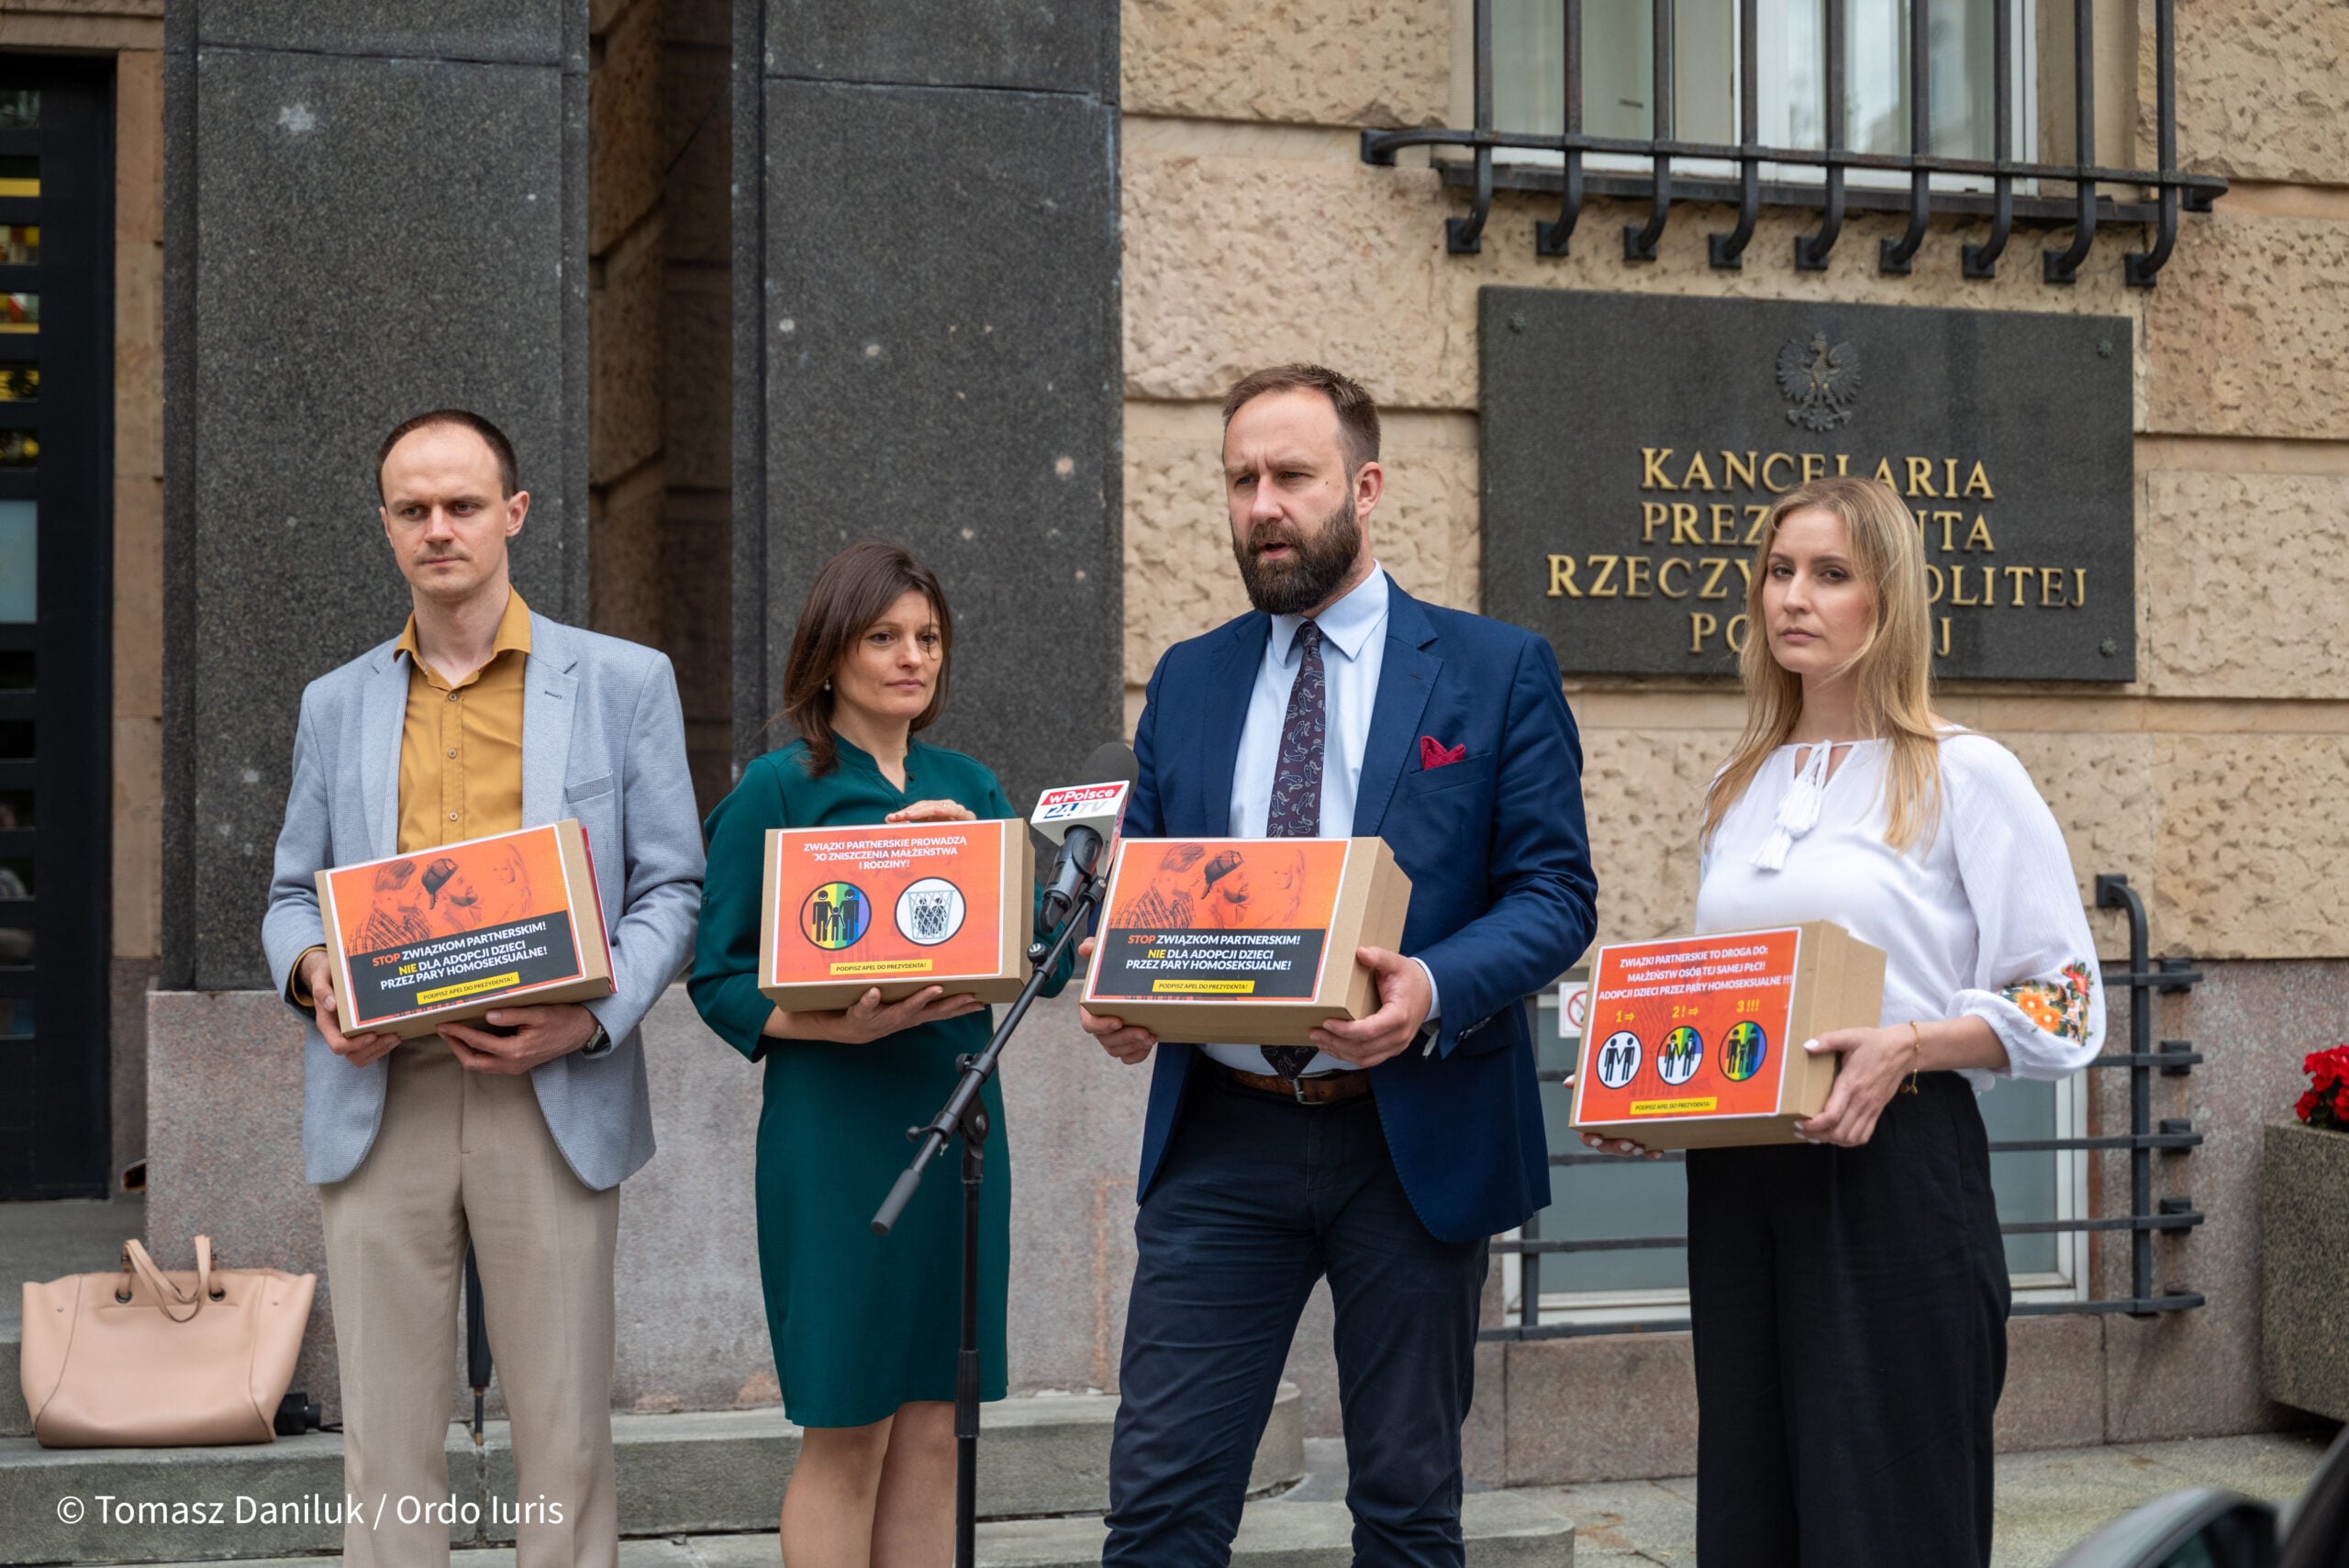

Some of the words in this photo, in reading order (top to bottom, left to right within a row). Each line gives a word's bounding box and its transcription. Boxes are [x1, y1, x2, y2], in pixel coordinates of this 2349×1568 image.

[1050, 789, 1115, 803] wPolsce
[804, 841, 845, 853] ZWIĄZKI
[846, 838, 909, 850] PARTNERSKIE
[911, 836, 967, 847] PROWADZĄ
[829, 850, 889, 861] ZNISZCZENIA
[891, 845, 957, 858] MAŁŻEŃSTWA
[863, 860, 909, 869] RODZINY!
[372, 952, 400, 967] STOP
[402, 940, 466, 962] ZWIĄZKOM
[467, 921, 547, 946] PARTNERSKIM!
[1128, 935, 1155, 944] STOP
[1157, 935, 1220, 946] ZWIĄZKOM
[1220, 935, 1300, 945] PARTNERSKIM!
[398, 963, 417, 975] NIE
[418, 959, 441, 972] DLA
[442, 948, 490, 968] ADOPCJI
[491, 940, 526, 956] DZIECI
[1148, 949, 1166, 959] NIE
[1167, 950, 1188, 959] DLA
[1190, 950, 1237, 959] ADOPCJI
[1239, 950, 1274, 959] DZIECI
[1620, 957, 1654, 968] ZWIĄZKI
[1655, 951, 1708, 964] PARTNERSKIE
[1709, 950, 1720, 959] TO
[1721, 948, 1752, 958] DROGA
[1753, 946, 1768, 955] DO:
[380, 975, 415, 990] PRZEZ
[416, 969, 445, 983] PARY
[447, 946, 548, 975] HOMOSEKSUALNE!
[1126, 960, 1159, 969] PRZEZ
[1160, 960, 1189, 970] PARY
[1190, 960, 1291, 971] HOMOSEKSUALNE!
[1628, 971, 1677, 982] MAŁŻEŃSTW
[1678, 966, 1701, 978] OSÓB
[1702, 967, 1716, 975] TEJ
[1717, 964, 1743, 973] SAMEJ
[1744, 962, 1765, 972] PŁCI!
[423, 992, 449, 1000] PODPISZ
[473, 977, 513, 989] PREZYDENTA!
[1598, 991, 1633, 1000] ADOPCJI
[1634, 987, 1659, 997] DZIECI
[1660, 985, 1685, 995] PRZEZ
[1686, 983, 1708, 993] PARY
[1708, 977, 1781, 991] HOMOSEKSUALNE
[1616, 1010, 1622, 1023] 1
